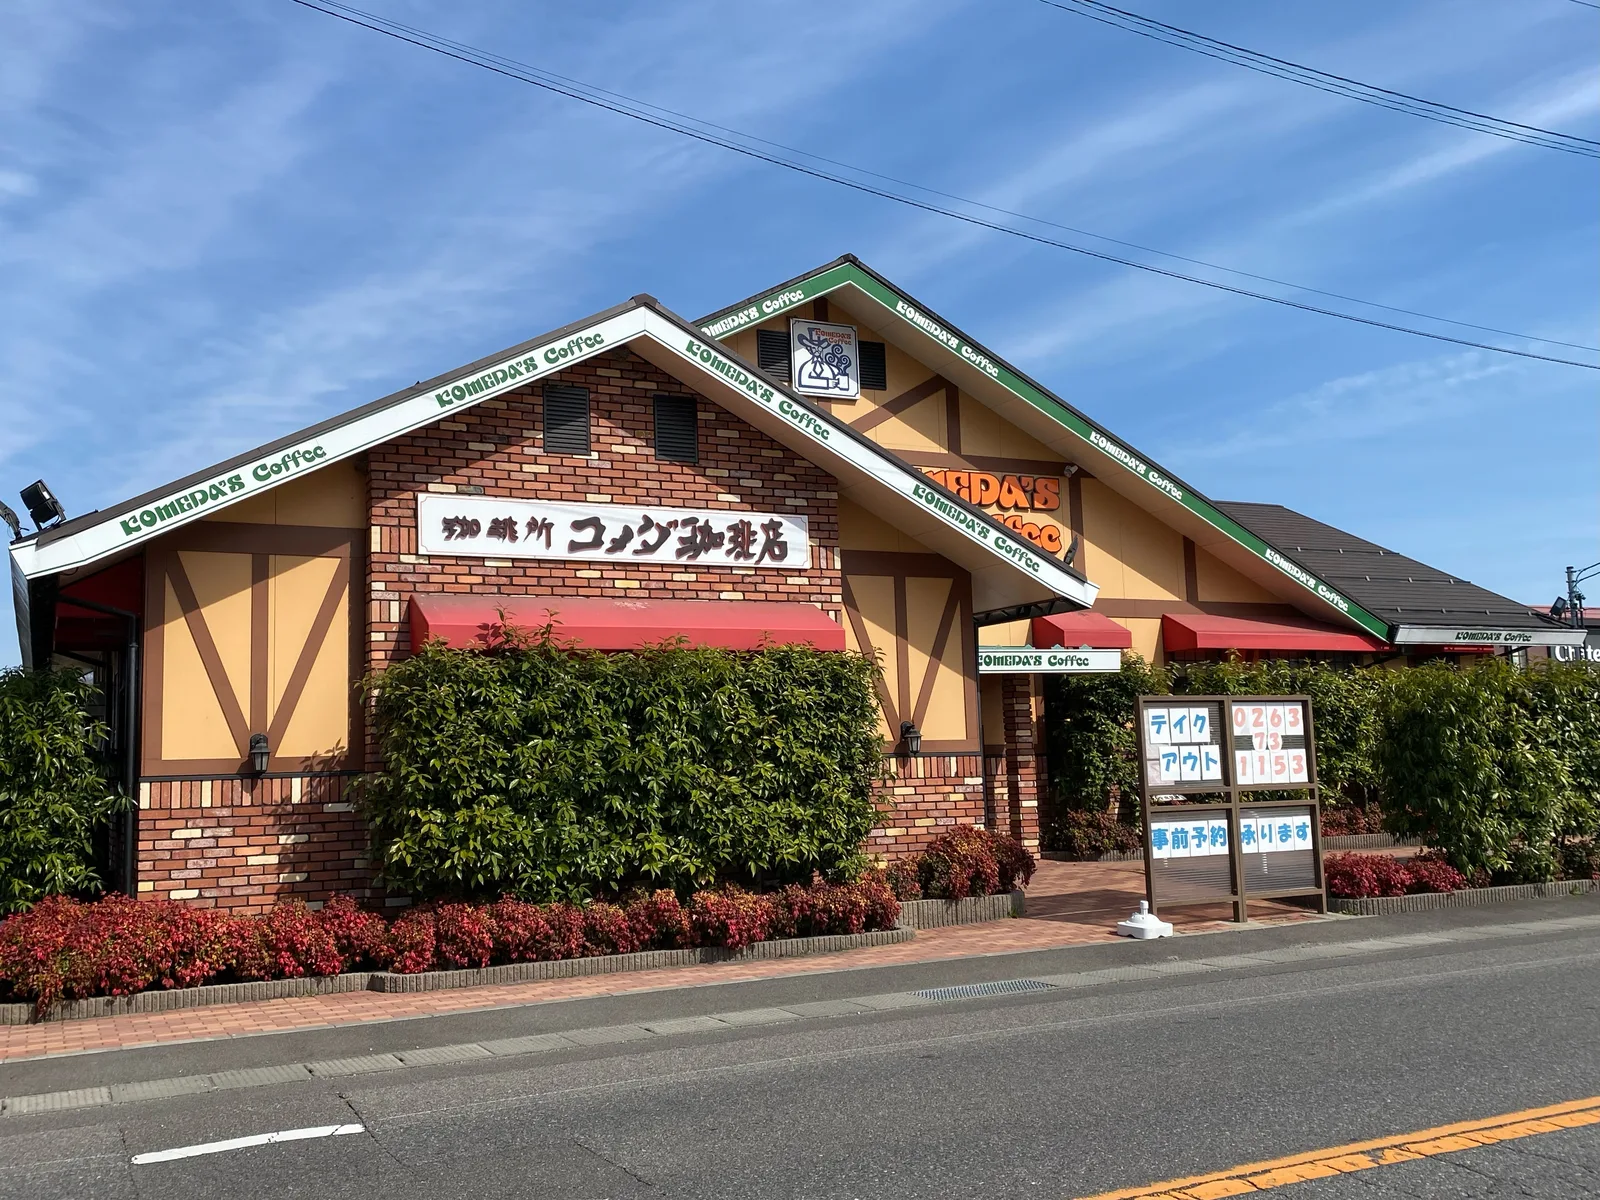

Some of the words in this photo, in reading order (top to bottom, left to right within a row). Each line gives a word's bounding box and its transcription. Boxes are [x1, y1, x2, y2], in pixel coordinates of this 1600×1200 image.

[762, 289, 805, 314] Coffee
[815, 328, 852, 340] KOMEDA'S
[828, 337, 852, 346] Coffee
[895, 299, 958, 350] KOMEDA'S
[961, 345, 999, 378] Coffee
[434, 354, 539, 409] KOMEDA'S
[543, 333, 605, 364] Coffee
[685, 339, 774, 404] KOMEDA'S
[778, 399, 830, 441] Coffee
[1089, 431, 1147, 475] KOMEDA'S
[1148, 471, 1183, 500] Coffee
[119, 473, 246, 536] KOMEDA'S
[252, 445, 327, 482] Coffee
[440, 514, 555, 551] 珈琲所
[567, 513, 789, 566] コメダ珈琲店
[912, 483, 991, 540] KOMEDA'S
[994, 535, 1040, 573] Coffee
[1264, 548, 1316, 589] KOMEDA'S
[1317, 584, 1349, 612] Coffee
[1454, 631, 1501, 641] KOMEDA'S
[1503, 632, 1533, 642] Coffee
[1047, 654, 1090, 667] Coffee
[1150, 713, 1207, 735] テイク
[1233, 707, 1301, 728] 0263
[1253, 732, 1282, 750] 73
[1161, 751, 1218, 772] アウト
[1239, 754, 1304, 777] 1153
[1151, 825, 1228, 850] 事前予約
[1240, 821, 1310, 846] 承ります
